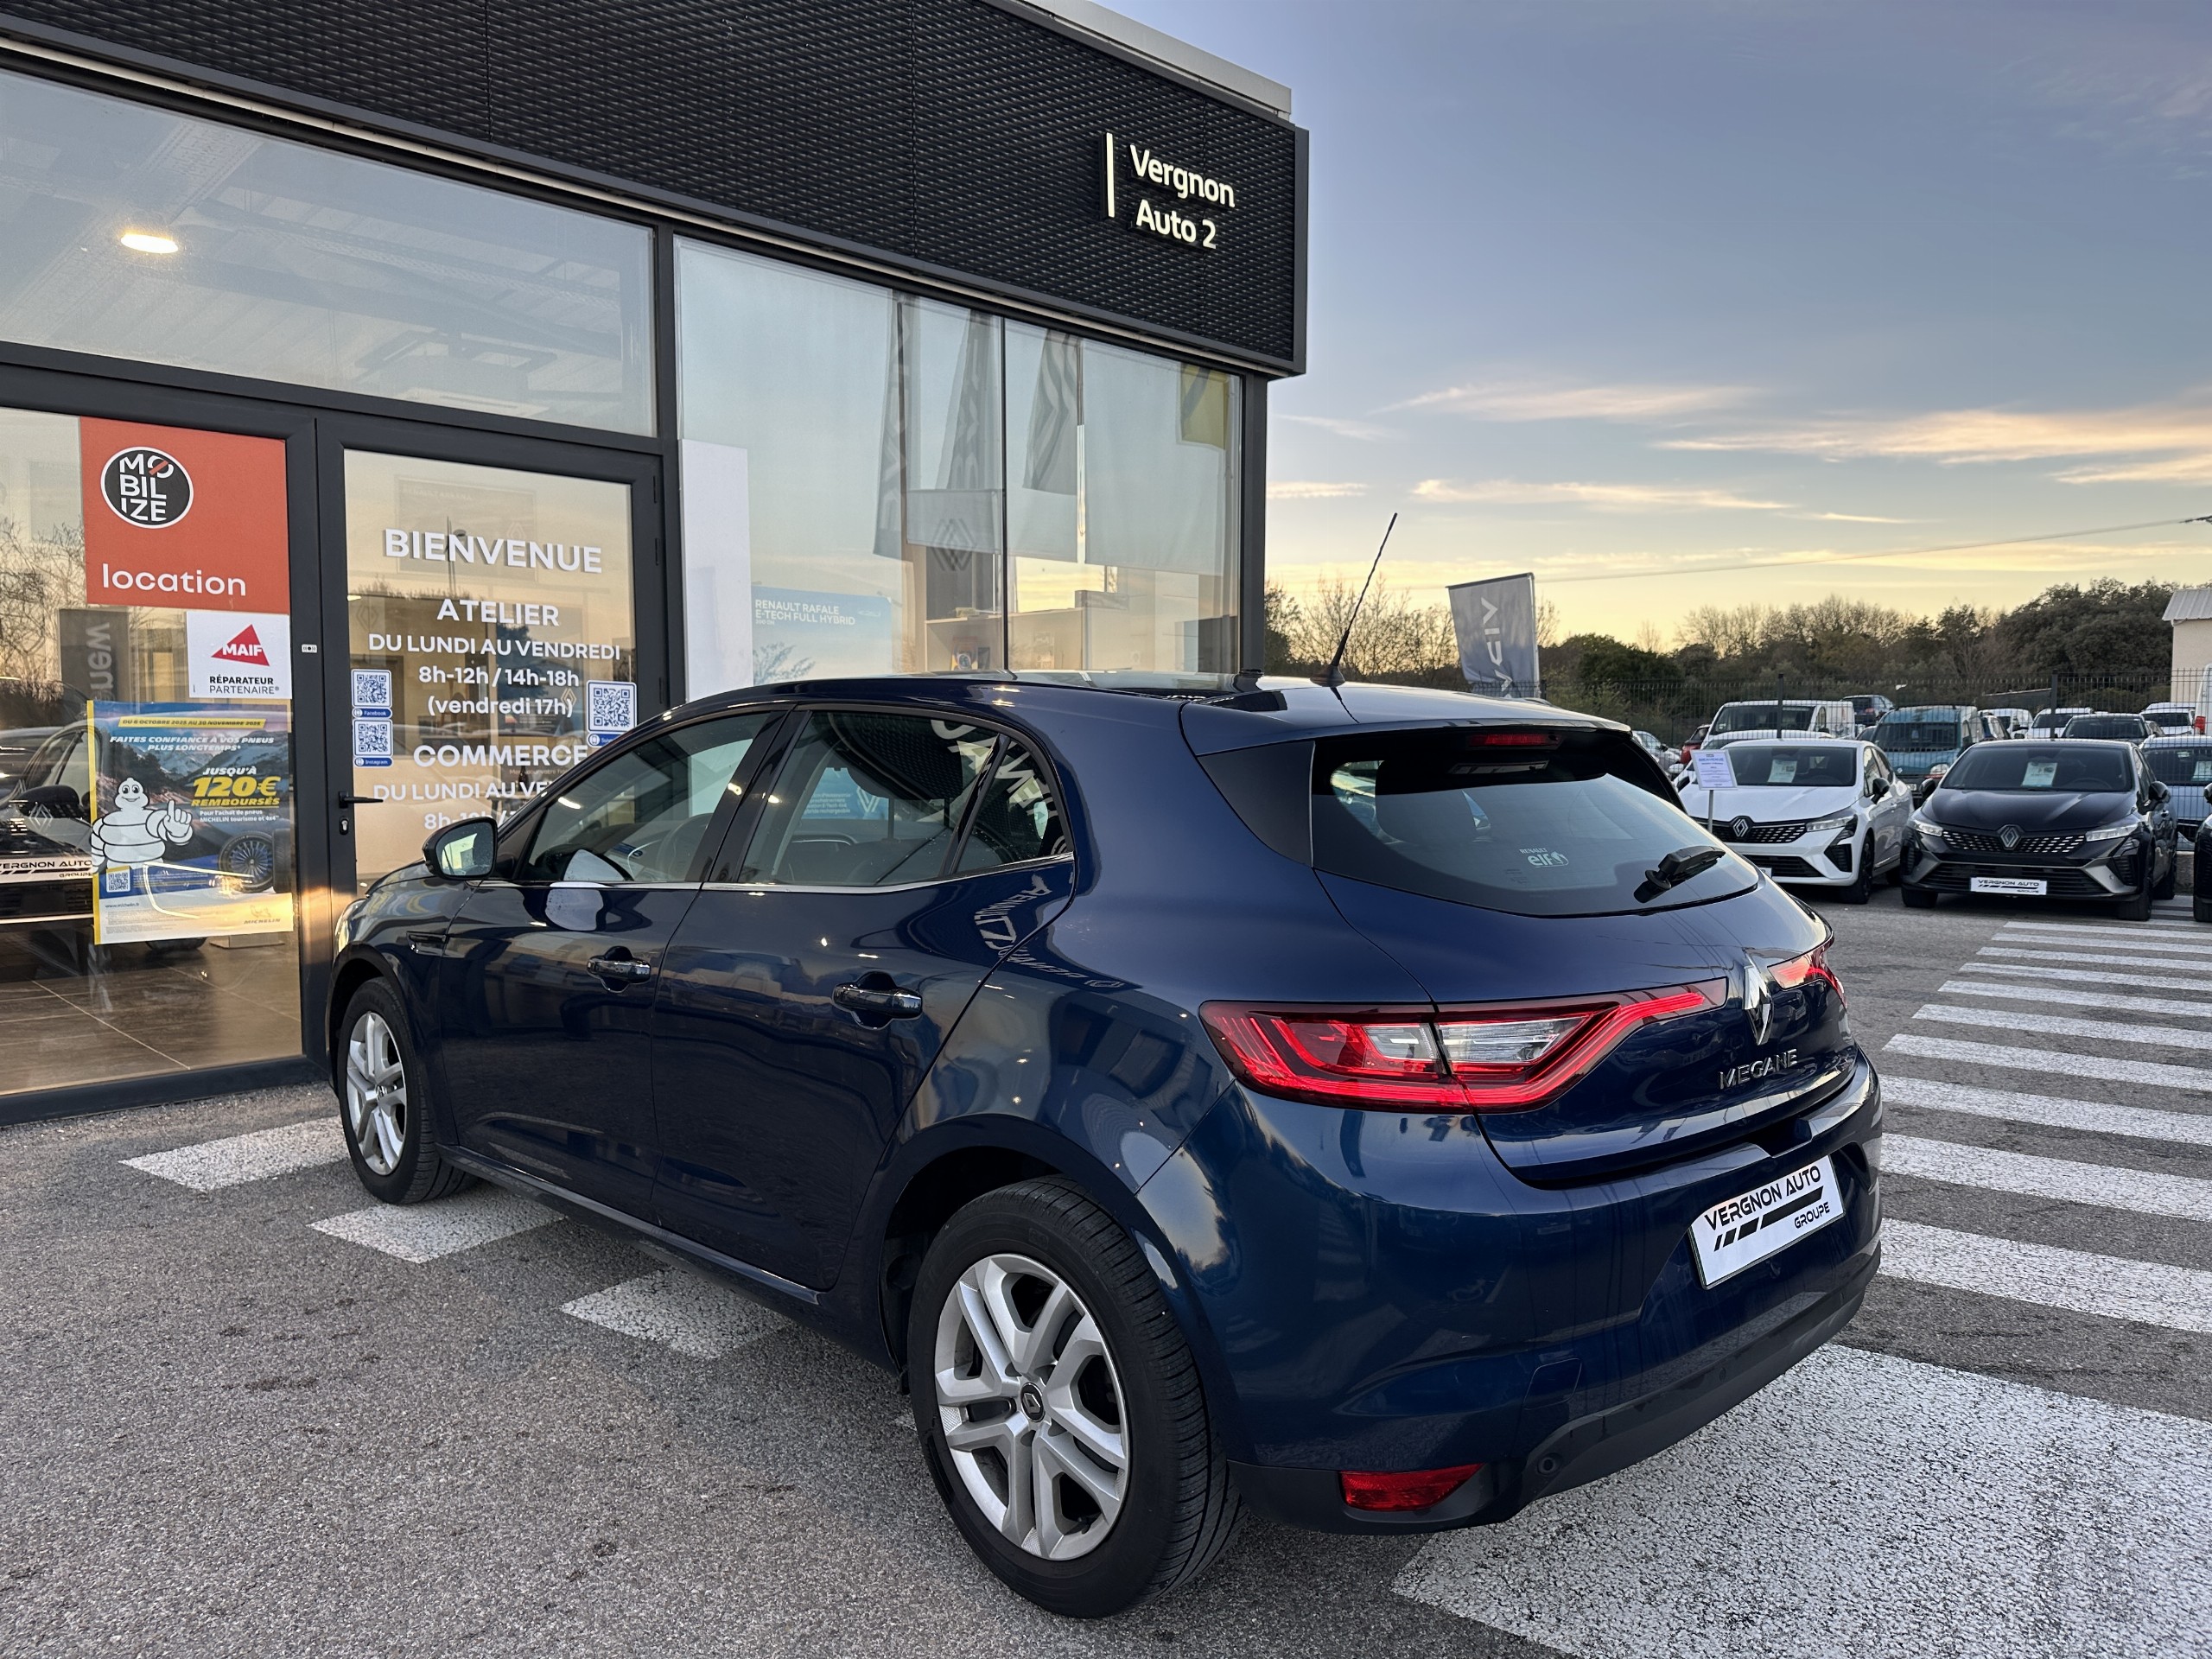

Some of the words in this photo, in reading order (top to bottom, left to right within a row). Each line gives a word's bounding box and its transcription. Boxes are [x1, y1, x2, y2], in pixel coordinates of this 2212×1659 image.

[1129, 144, 1236, 207] Vergnon
[1135, 199, 1197, 243] Auto
[1202, 219, 1217, 249] 2
[385, 528, 602, 574] BIENVENUE
[102, 563, 246, 596] location
[437, 598, 560, 626] ATELIER
[755, 600, 801, 612] RENAULT
[803, 604, 840, 615] RAFALE
[755, 609, 791, 620] E-TECH
[793, 613, 817, 623] FULL
[820, 614, 855, 626] HYBRID
[222, 644, 263, 657] MAIF
[369, 633, 402, 652] DU
[408, 635, 475, 655] LUNDI
[480, 639, 512, 657] AU
[515, 640, 620, 661] VENDREDI
[209, 674, 274, 685] RÉPARATEUR
[418, 666, 488, 684] 8h-12h
[505, 668, 579, 688] 14h-18h
[428, 696, 531, 715] (vendredi
[535, 697, 574, 718] 17h)
[413, 745, 588, 767] COMMERCE
[202, 766, 257, 777] JUSQU'À
[193, 775, 282, 797] 120€
[373, 785, 406, 801] DU
[412, 783, 480, 800] LUNDI
[485, 782, 516, 798] AU
[519, 781, 553, 798] VE
[191, 797, 280, 807] REMBOURSÉS
[1527, 854, 1554, 866] elf
[1719, 1048, 1798, 1090] MEGANE
[1705, 1183, 1783, 1231] VERGNON
[1785, 1165, 1821, 1197] AUTO
[1794, 1202, 1830, 1230] GROUPE
